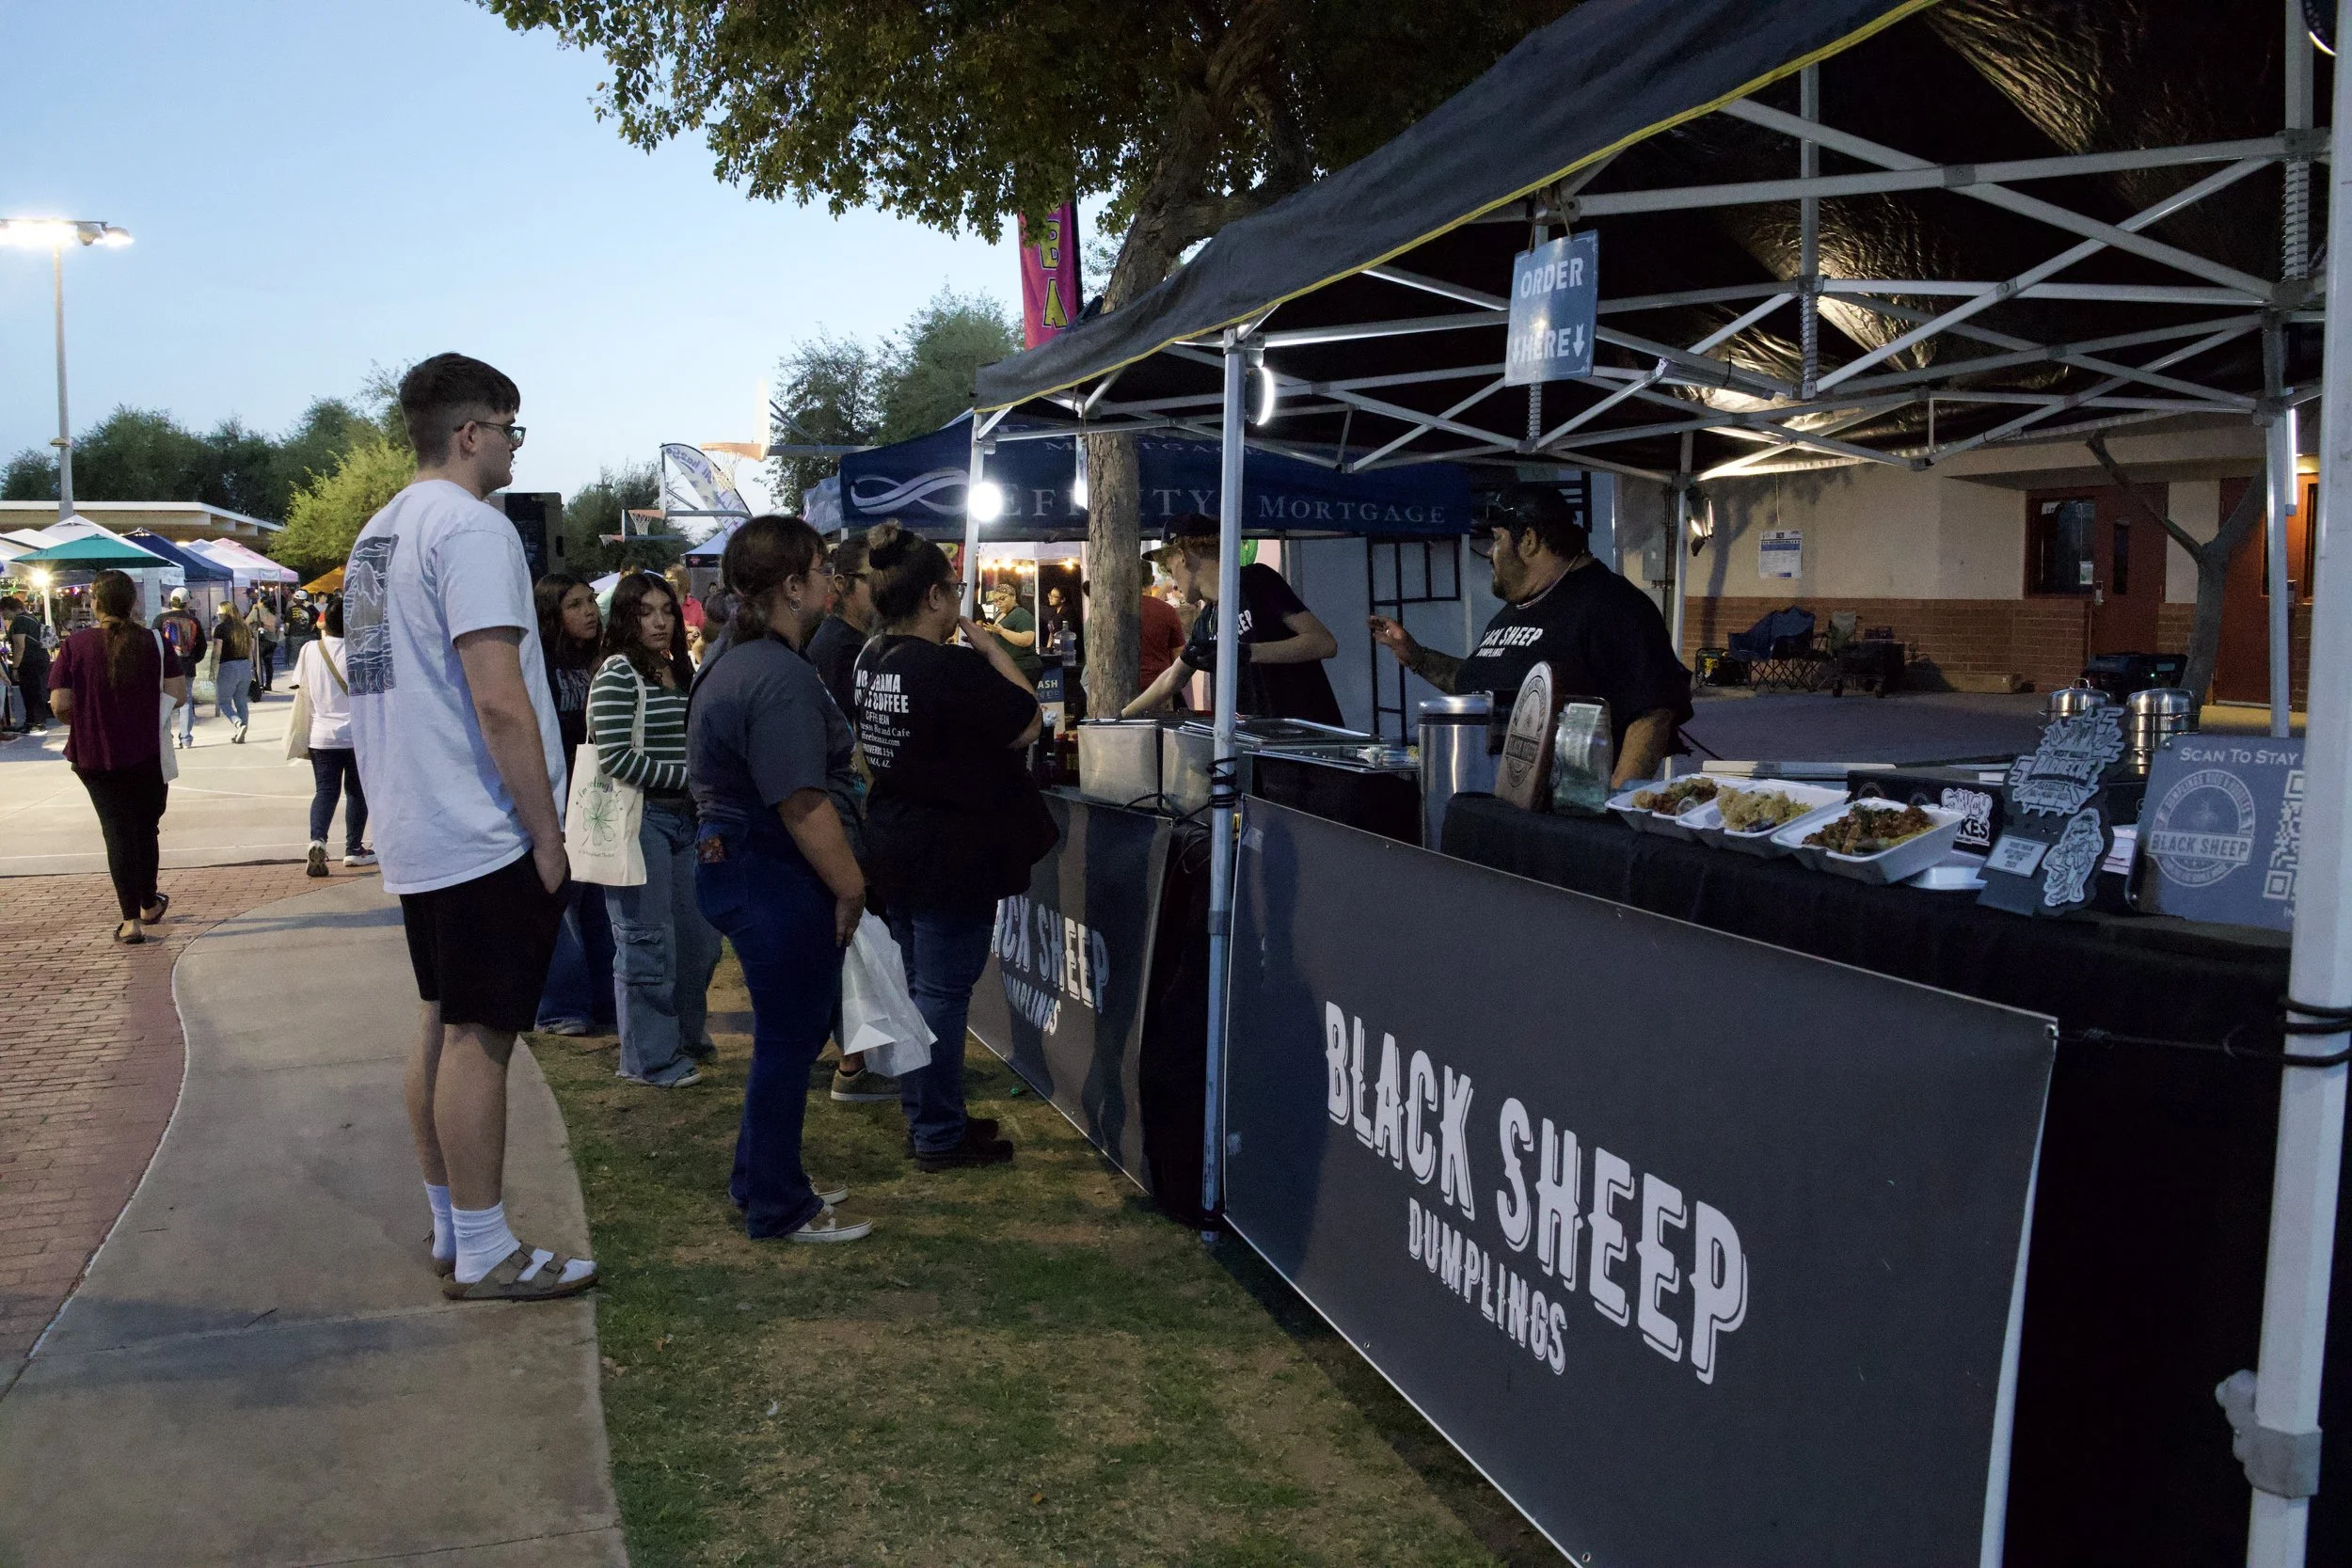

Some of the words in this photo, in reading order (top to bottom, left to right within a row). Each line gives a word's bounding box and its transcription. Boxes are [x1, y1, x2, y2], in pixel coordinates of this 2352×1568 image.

[1520, 258, 1583, 298] ORDER
[1520, 327, 1572, 363] HERE
[1258, 495, 1445, 524] MORTGAGE
[1499, 626, 1544, 647] SHEEP
[855, 669, 869, 689] NO
[872, 691, 910, 714] COFFEE
[878, 713, 890, 725] BEAN
[891, 727, 911, 737] Cafe
[2180, 747, 2225, 763] SCAN
[2230, 748, 2252, 764] TO
[2255, 749, 2299, 766] STAY
[1958, 816, 1989, 839] KES
[2152, 832, 2197, 854] BLACK
[2200, 836, 2249, 860] SHEEP
[1037, 903, 1110, 1015] SHEEP
[1325, 1001, 1475, 1221] BLACK
[1497, 1097, 1748, 1385] SHEEP
[1409, 1197, 1567, 1375] DUMPLINGS
